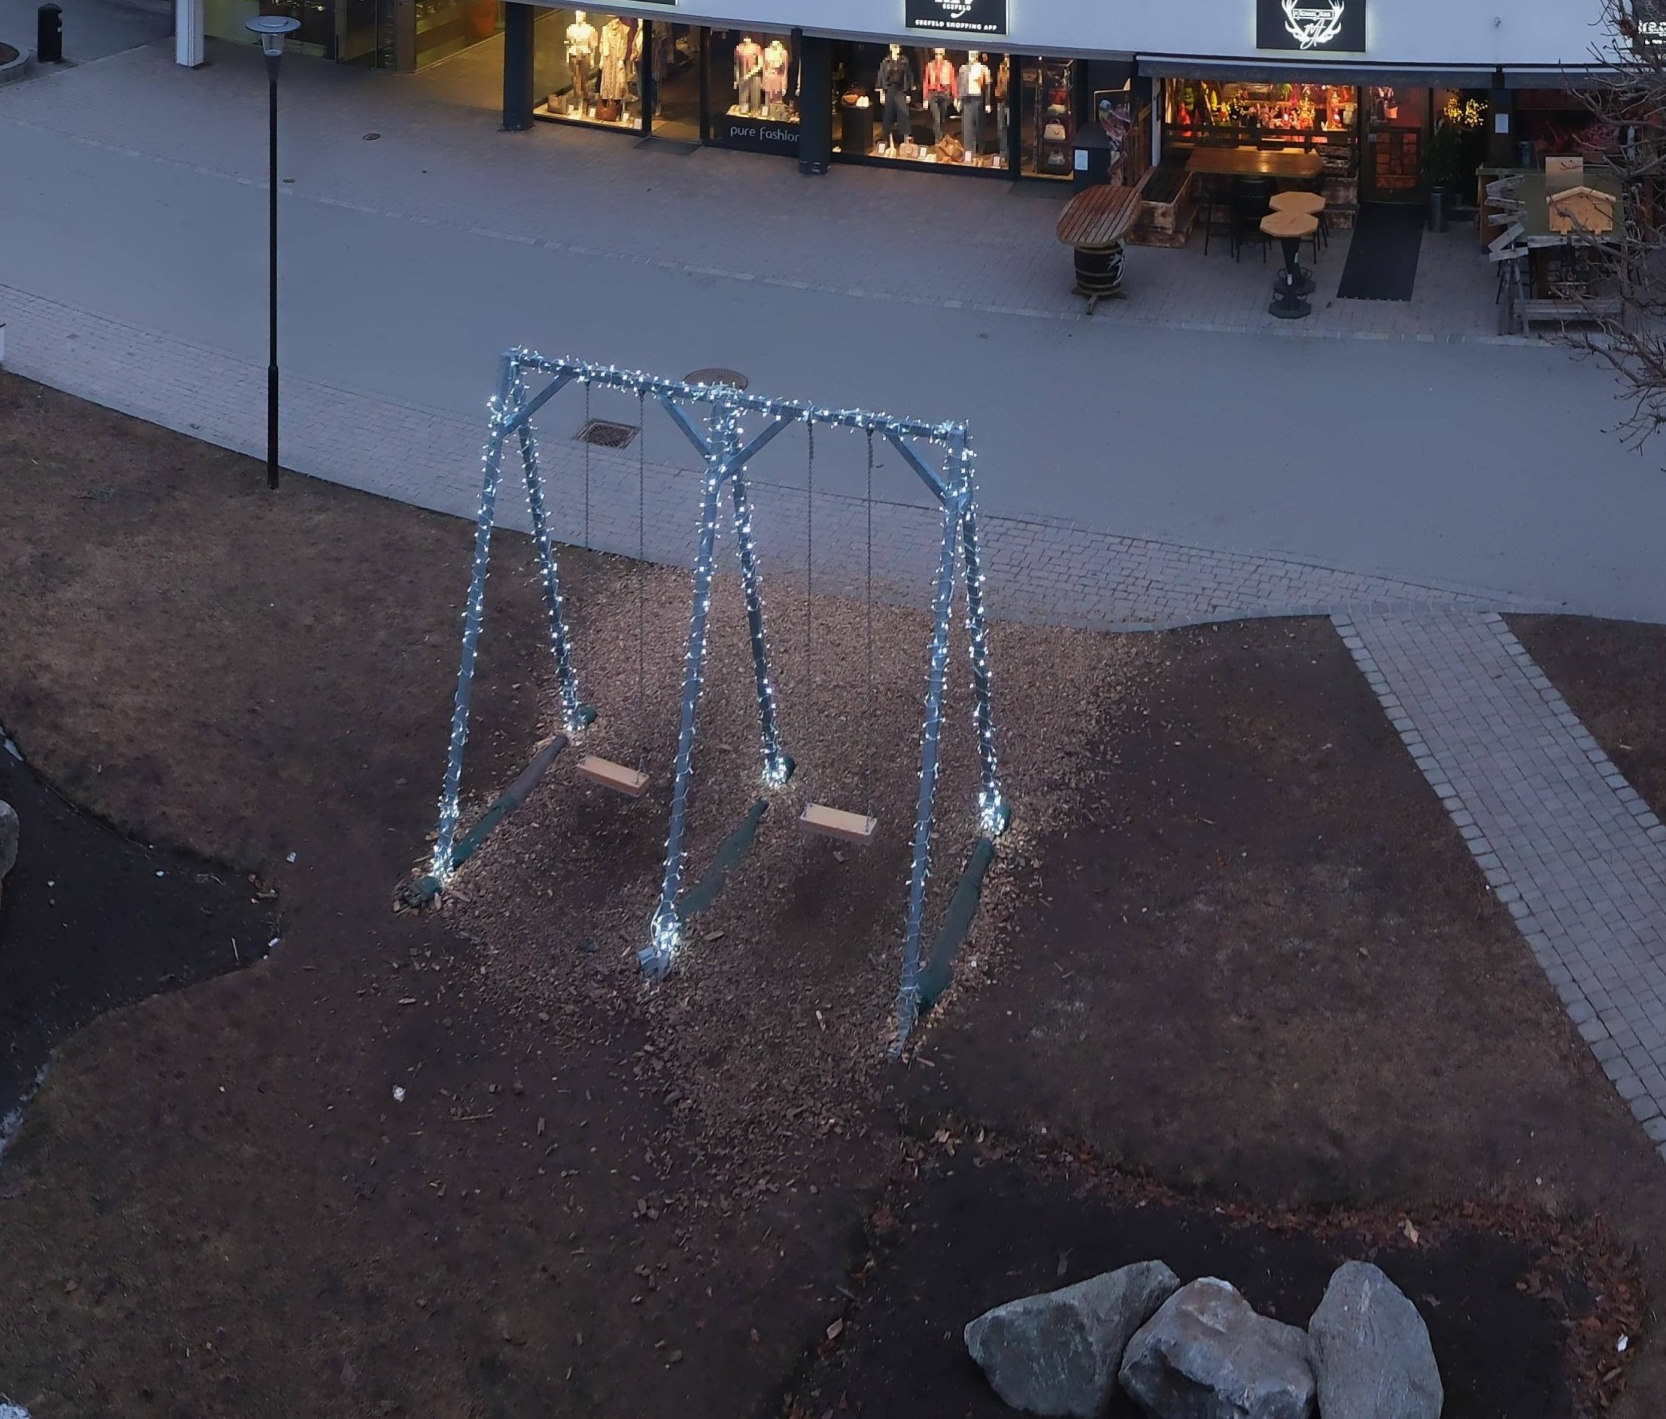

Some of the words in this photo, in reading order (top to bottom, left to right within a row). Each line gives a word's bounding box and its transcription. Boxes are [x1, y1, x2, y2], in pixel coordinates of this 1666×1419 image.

[942, 3, 971, 11] SEEFELD
[915, 20, 944, 28] SEEFELD
[946, 22, 982, 30] SHOPPING
[730, 126, 756, 137] pure
